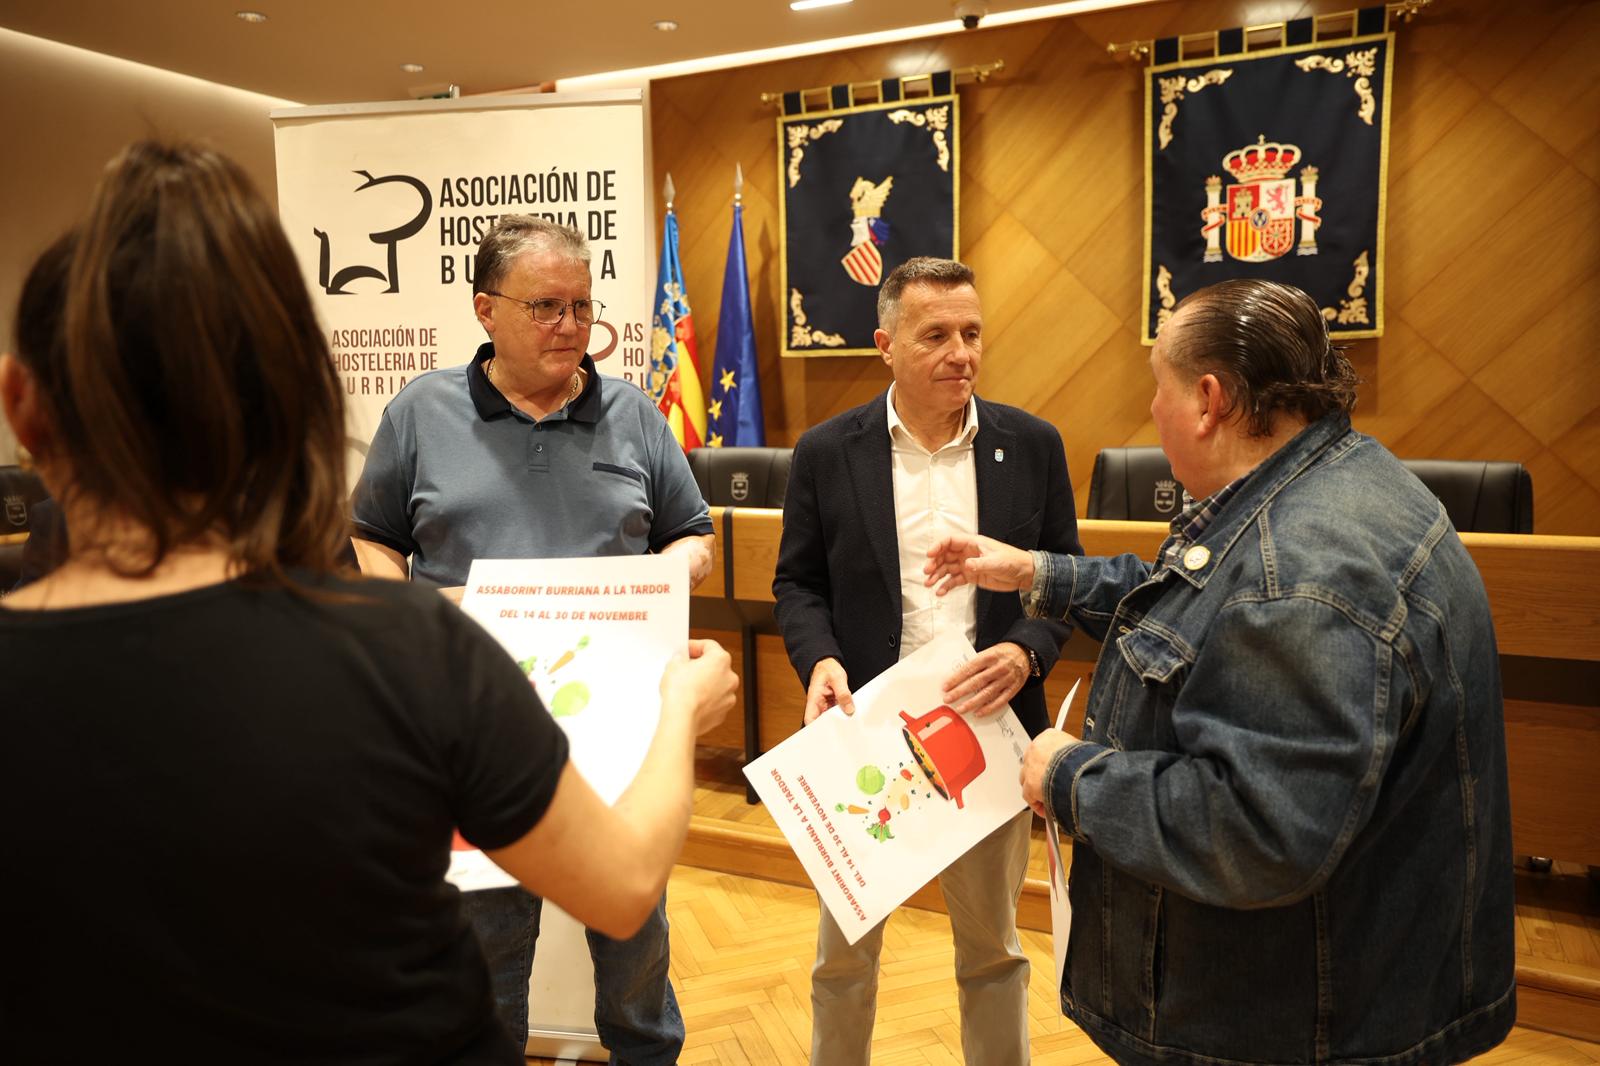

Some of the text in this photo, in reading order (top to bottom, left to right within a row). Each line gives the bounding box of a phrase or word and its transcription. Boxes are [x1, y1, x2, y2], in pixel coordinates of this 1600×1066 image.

[440, 166, 616, 207] ASOCIACIÓN DE
[588, 210, 617, 241] DE
[332, 324, 438, 348] ASOCIACIÓN DE
[333, 352, 438, 371] HOSTELERIA DE
[476, 584, 670, 595] ASSABORINT BURRIANA A LA TARDOR
[499, 609, 648, 621] DEL 14 AL 30 DE NOVEMBRE
[770, 768, 867, 921] ASSABORINT BURRIANA A LA TARDOR
[797, 775, 867, 887] DEL 14 AL 30 DE NOVEMBRE
